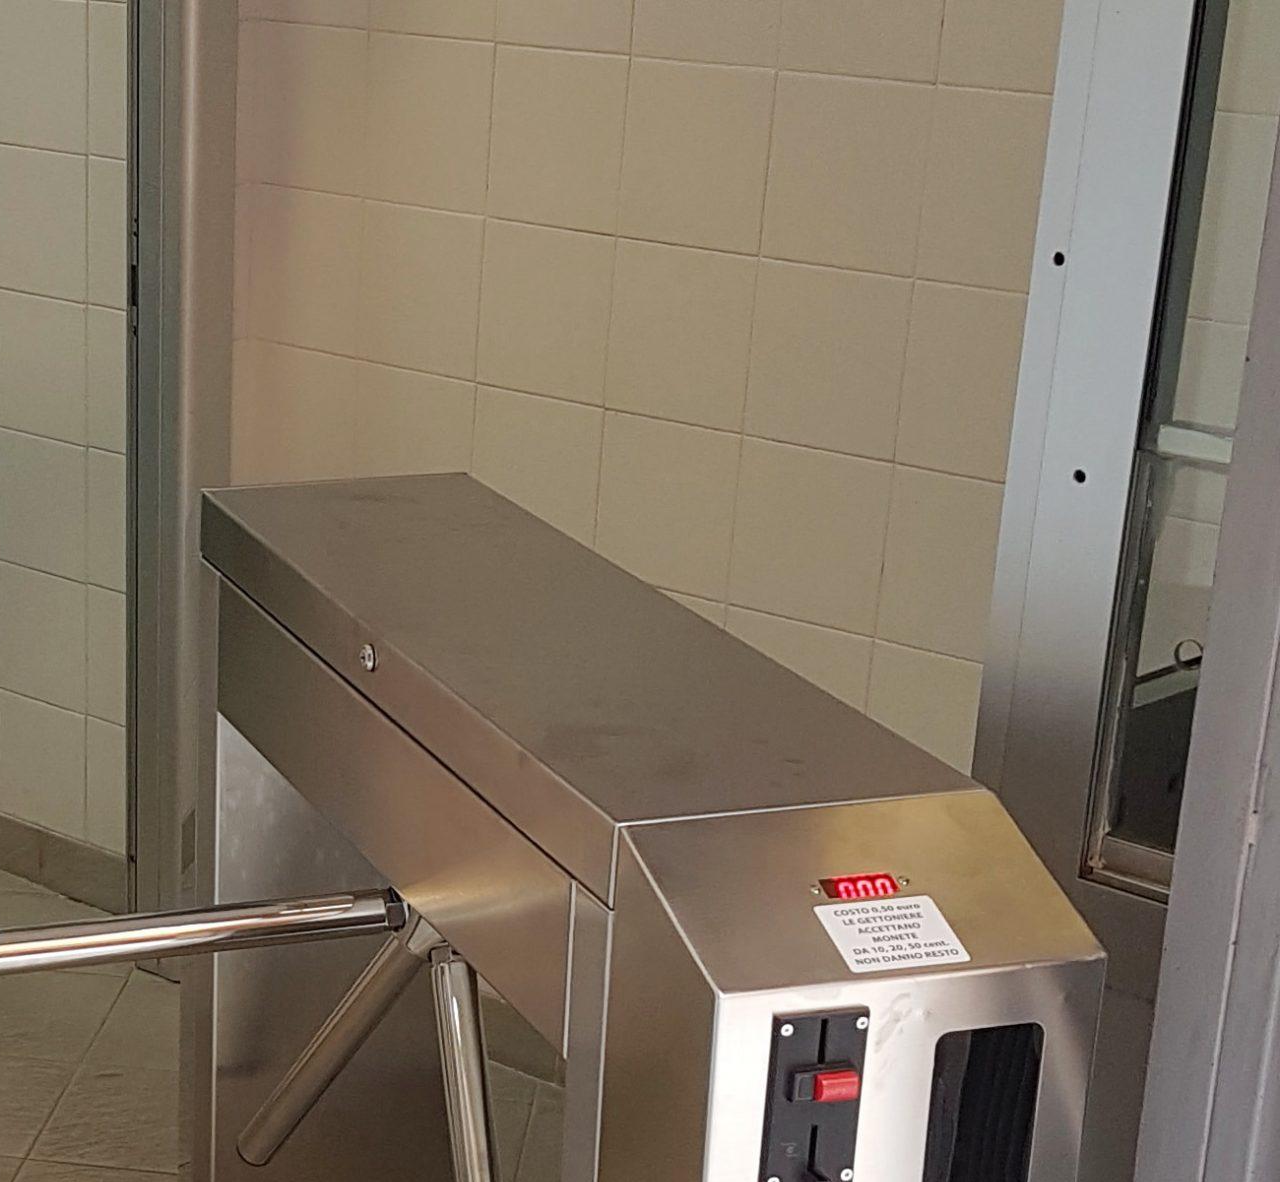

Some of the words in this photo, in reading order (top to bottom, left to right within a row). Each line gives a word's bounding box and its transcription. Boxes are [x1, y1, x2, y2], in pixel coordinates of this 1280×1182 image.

[833, 907, 870, 917] COSTO
[871, 905, 894, 914] 0,50
[896, 903, 920, 911] euro
[842, 918, 856, 926] LE
[857, 912, 924, 924] GETTONIERE
[858, 922, 920, 934] ACCETTANO
[871, 932, 919, 943] MONETE
[852, 947, 870, 955] DA
[923, 940, 950, 948] cent.
[854, 955, 880, 965] NON
[882, 952, 923, 962] DANNO
[924, 948, 959, 958] RESTO
